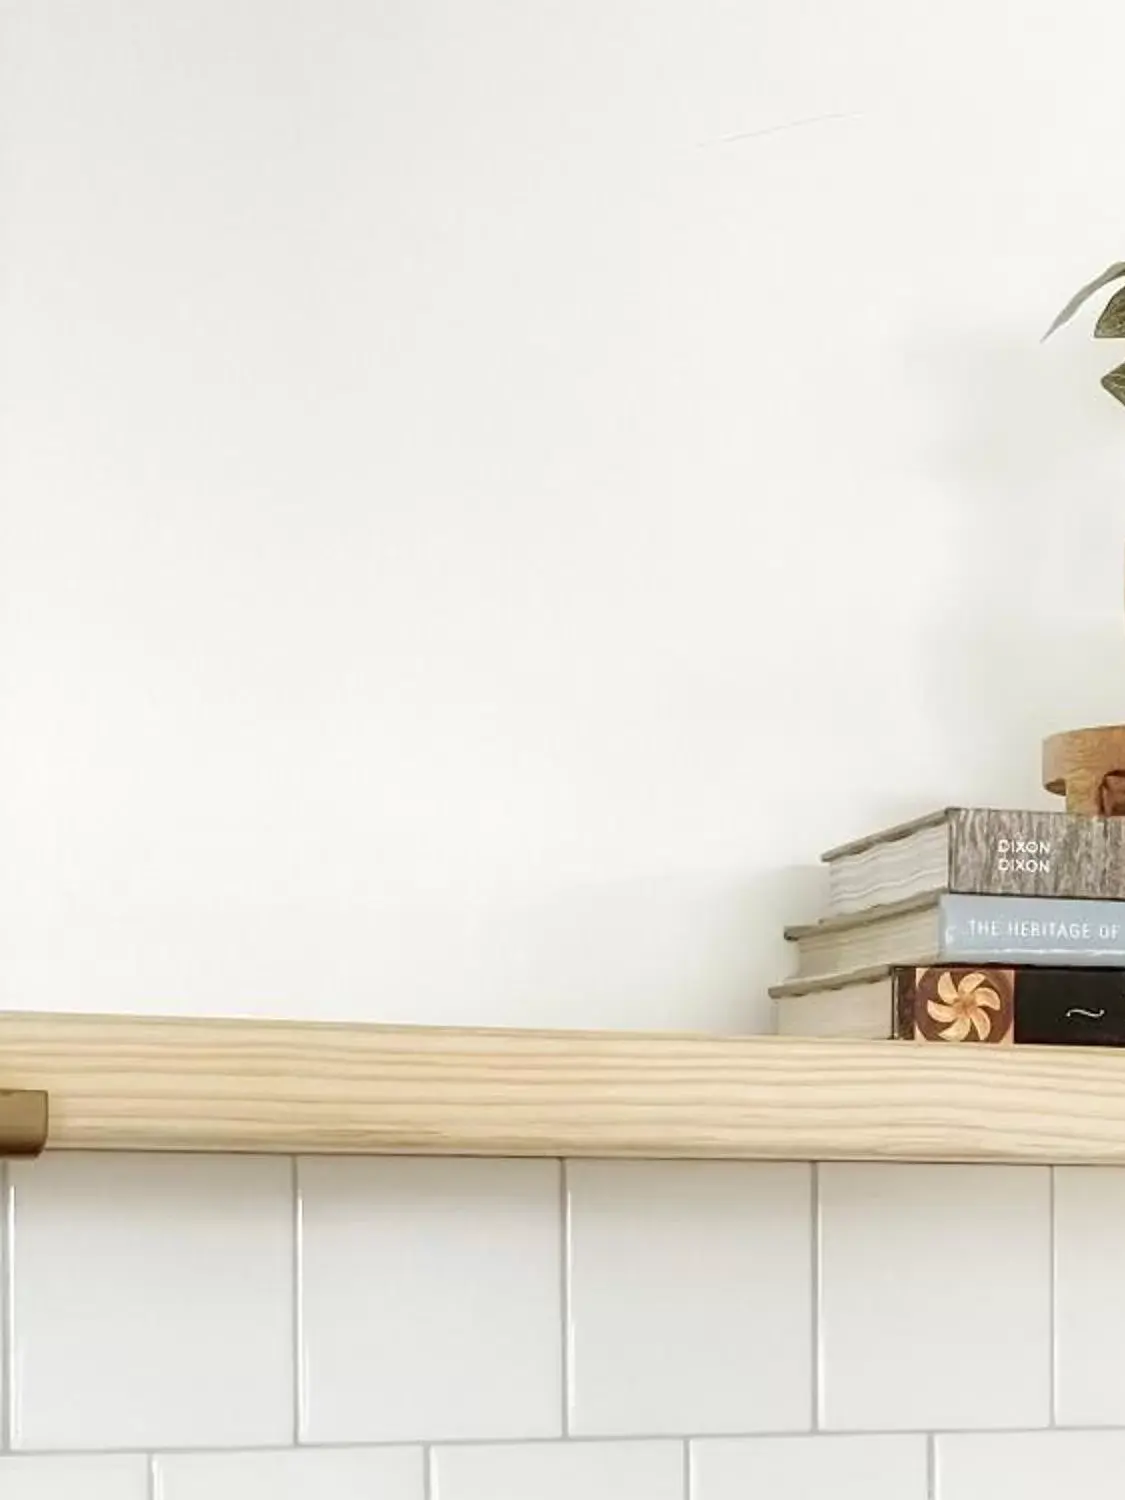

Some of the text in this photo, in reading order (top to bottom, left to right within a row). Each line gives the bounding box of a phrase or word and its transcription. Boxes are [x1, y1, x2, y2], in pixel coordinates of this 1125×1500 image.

[998, 839, 1051, 854] DIXON
[998, 859, 1051, 873] DIXON
[967, 919, 1001, 936] THE
[1009, 919, 1091, 940] HERITAGE
[1099, 922, 1121, 940] OF
